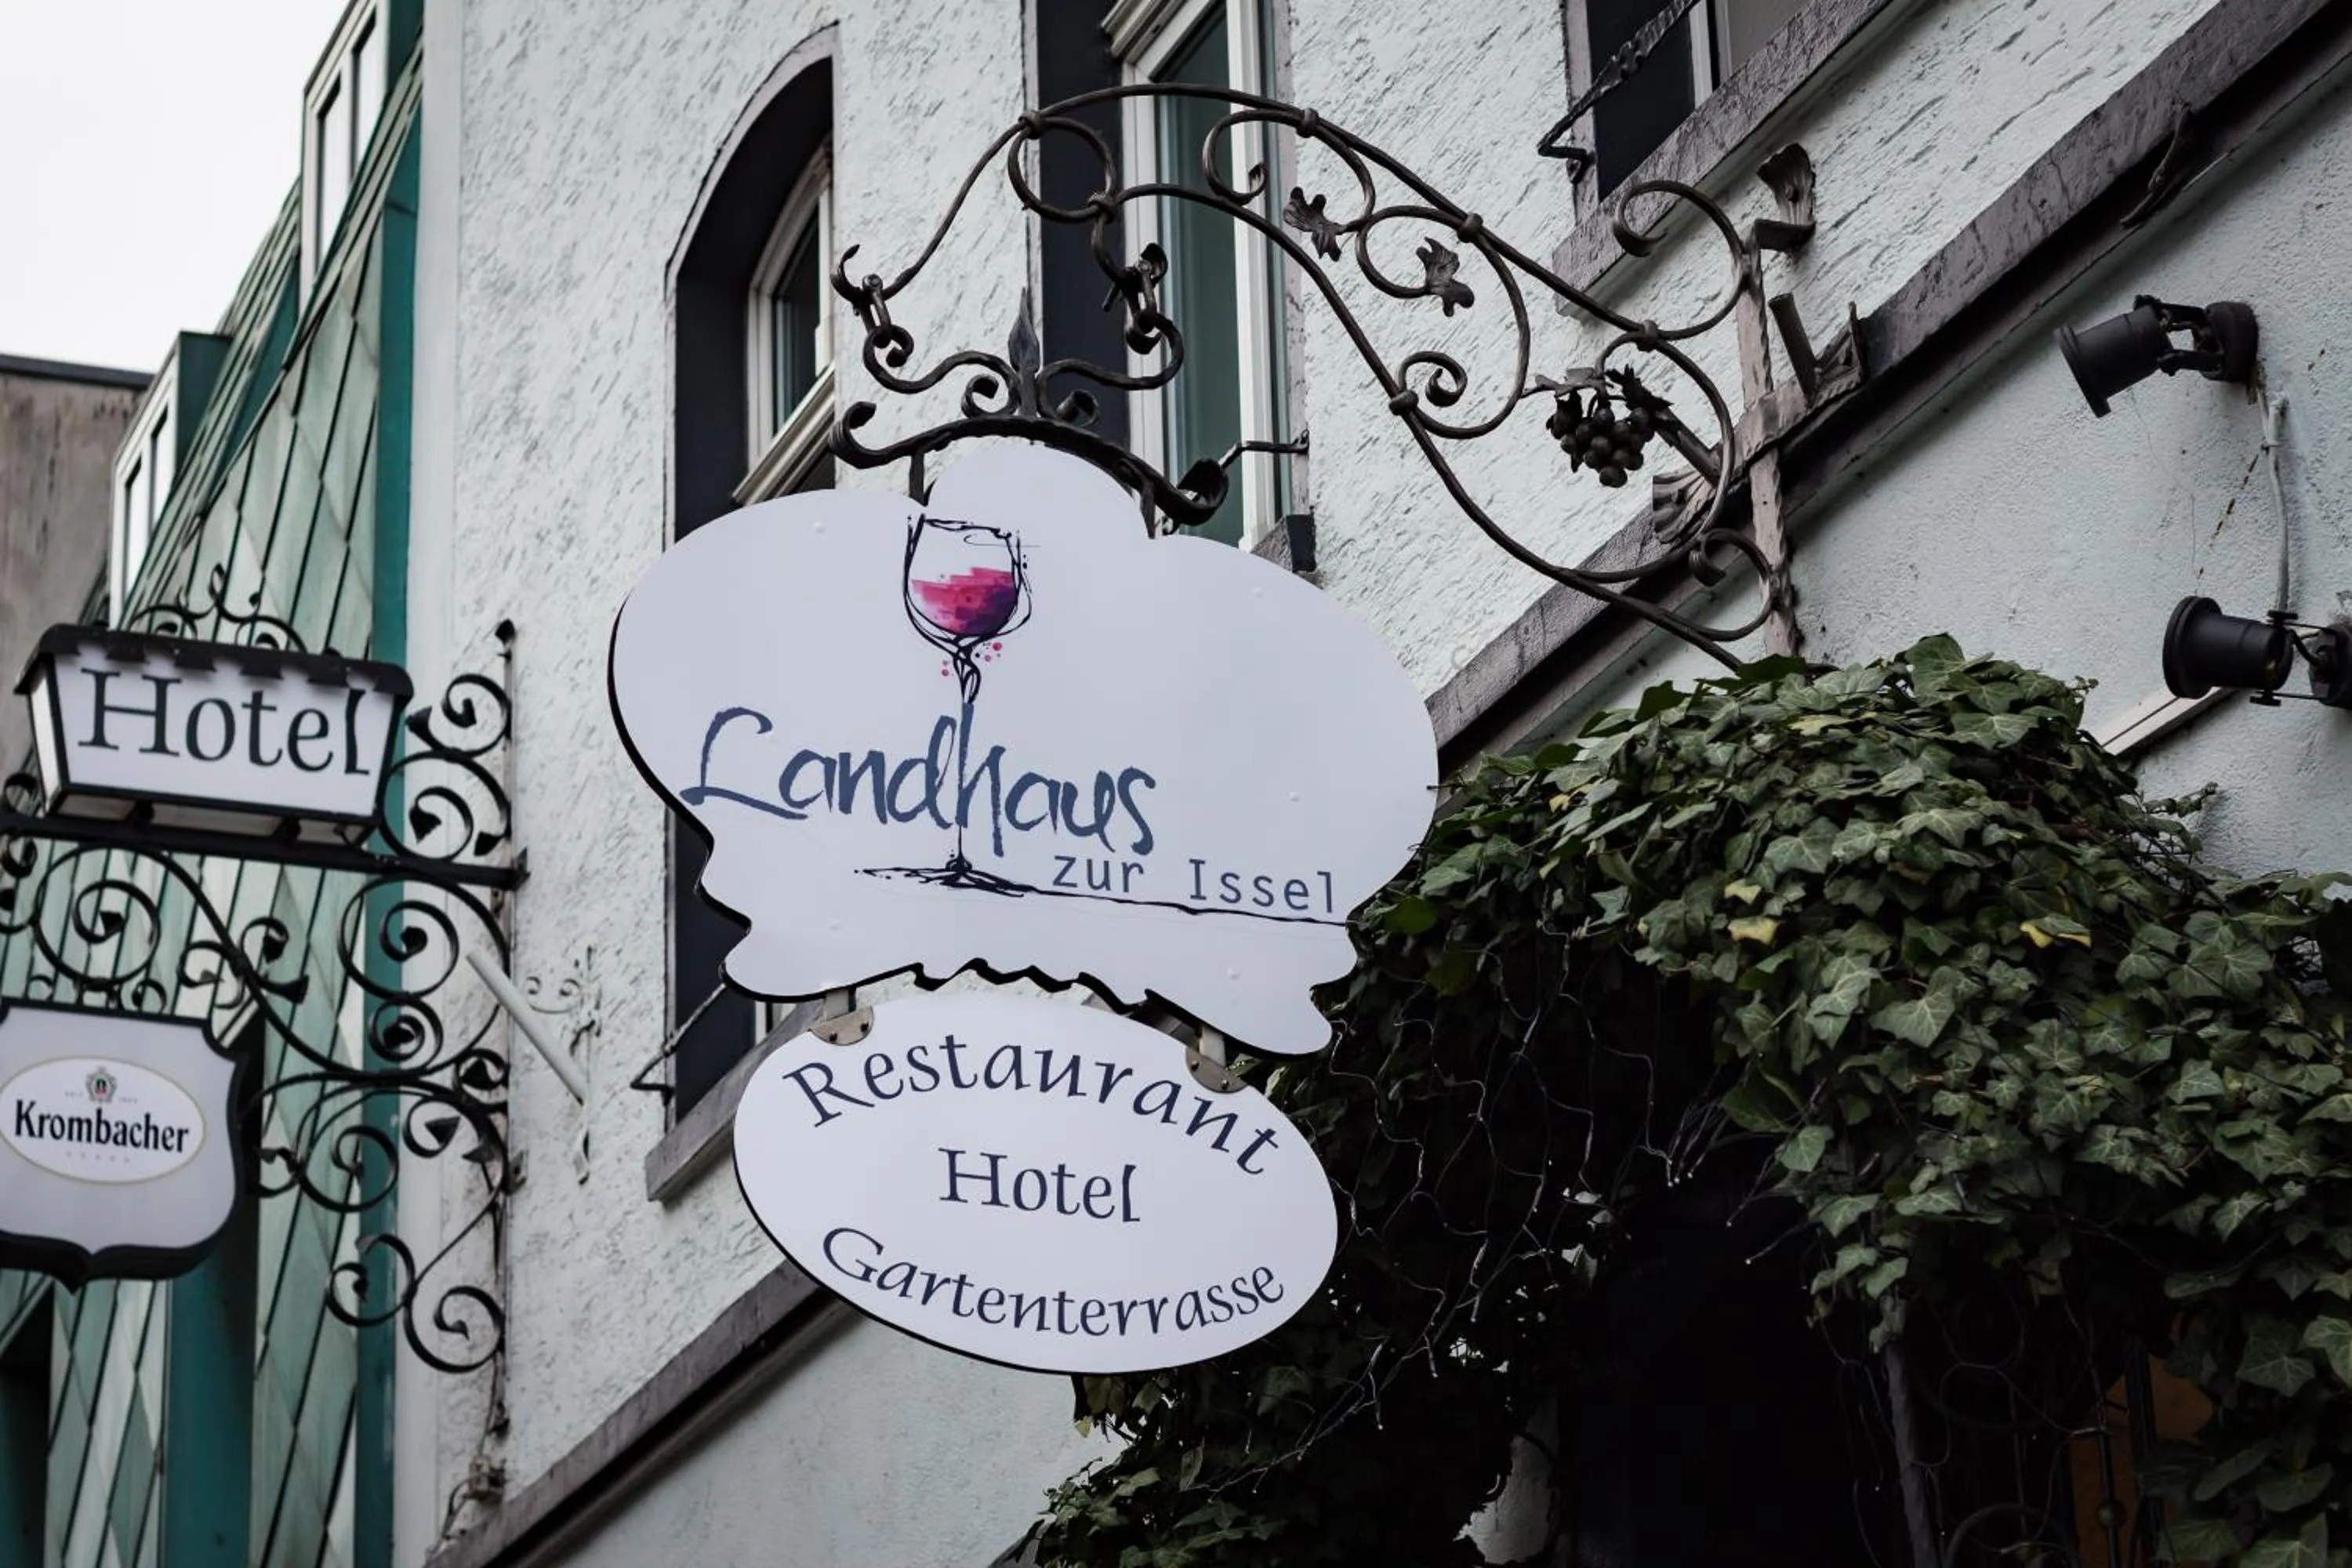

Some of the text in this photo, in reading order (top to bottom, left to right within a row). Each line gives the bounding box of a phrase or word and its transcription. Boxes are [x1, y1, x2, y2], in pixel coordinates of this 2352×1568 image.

[78, 667, 371, 775] Hotel
[679, 702, 1156, 858] Landhaus
[1052, 855, 1334, 914] zur Issel
[15, 1099, 189, 1153] Krombacher
[782, 1033, 1279, 1176] Restaurant
[938, 1147, 1141, 1223] Hotel
[822, 1227, 1284, 1337] Gartenterrasse
